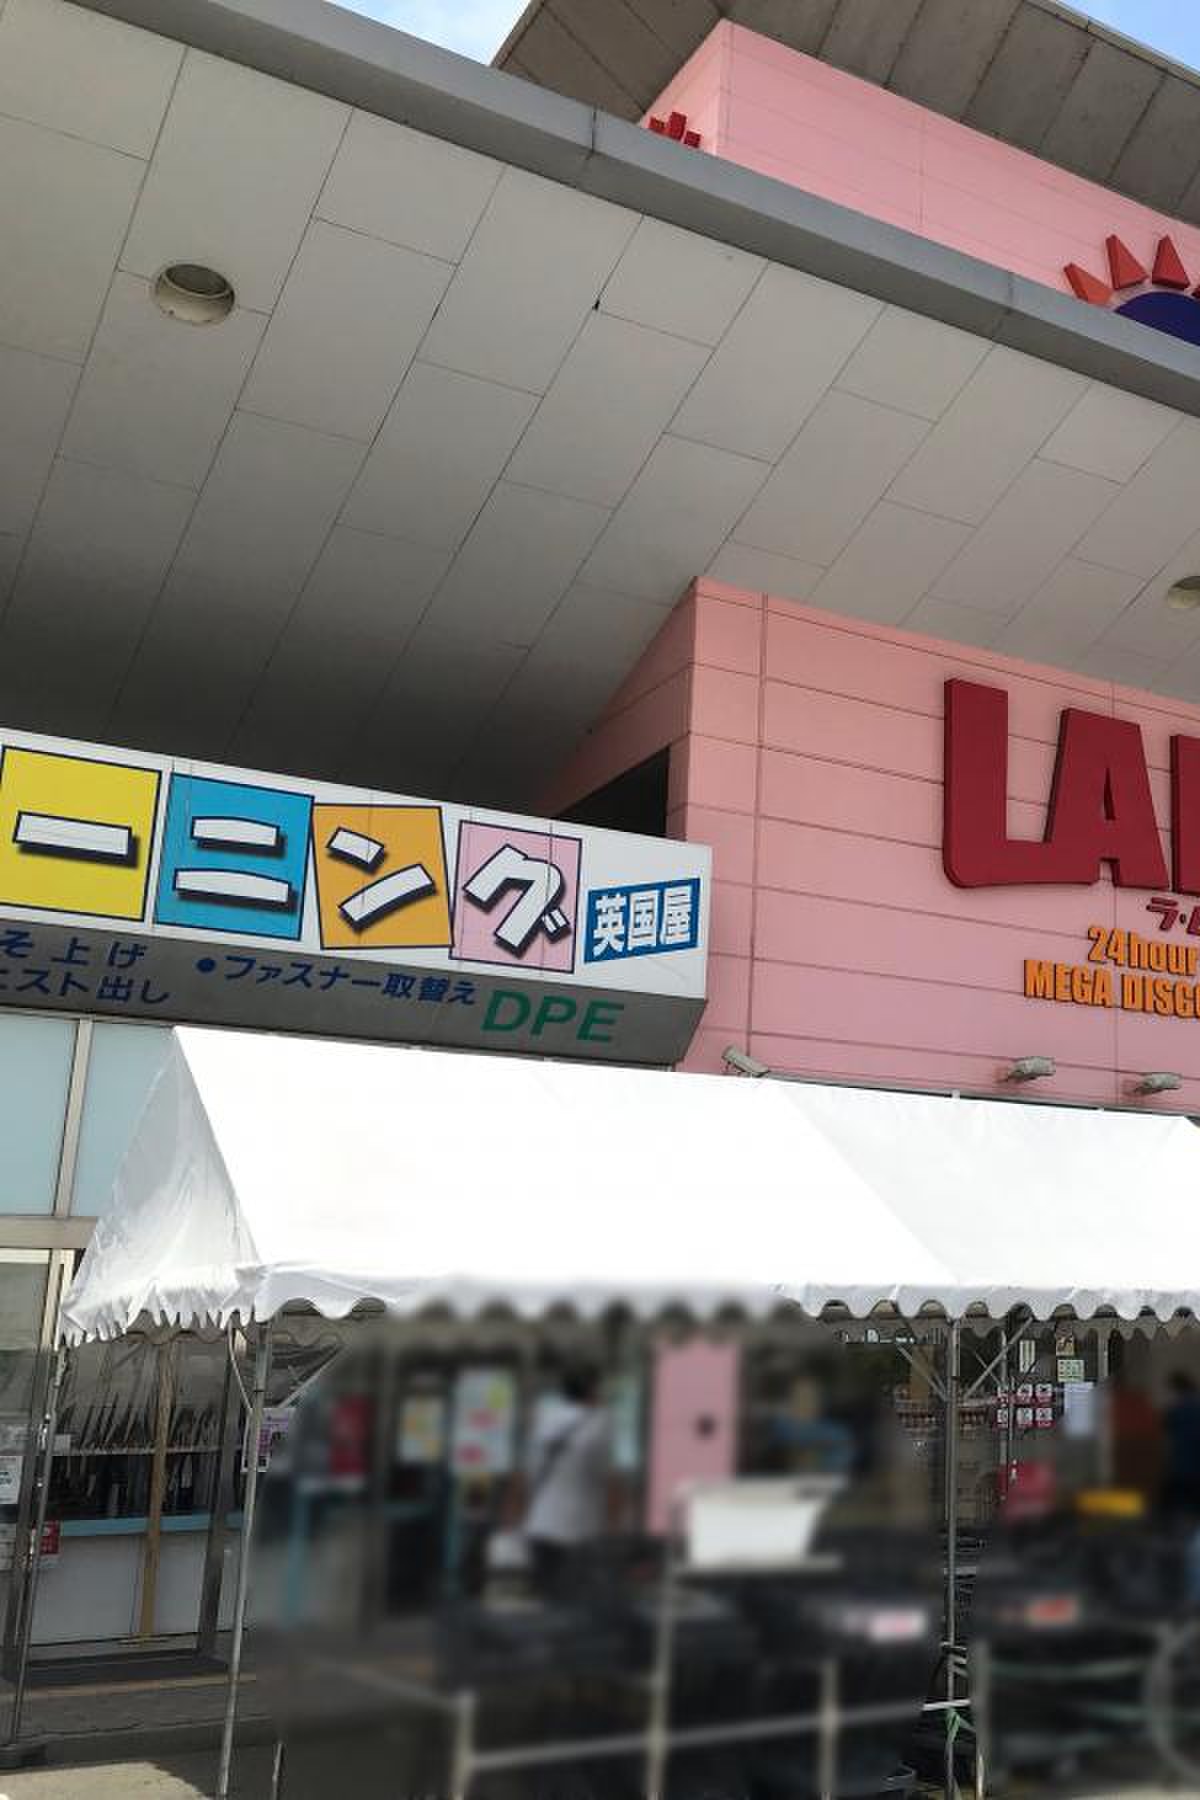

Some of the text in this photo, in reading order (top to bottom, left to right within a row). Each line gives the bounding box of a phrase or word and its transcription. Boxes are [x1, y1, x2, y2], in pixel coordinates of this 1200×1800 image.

[593, 884, 692, 957] 英国屋
[224, 954, 476, 1006] ファスナー取替え
[1023, 958, 1113, 1010] MEGA
[480, 989, 625, 1043] DPE
